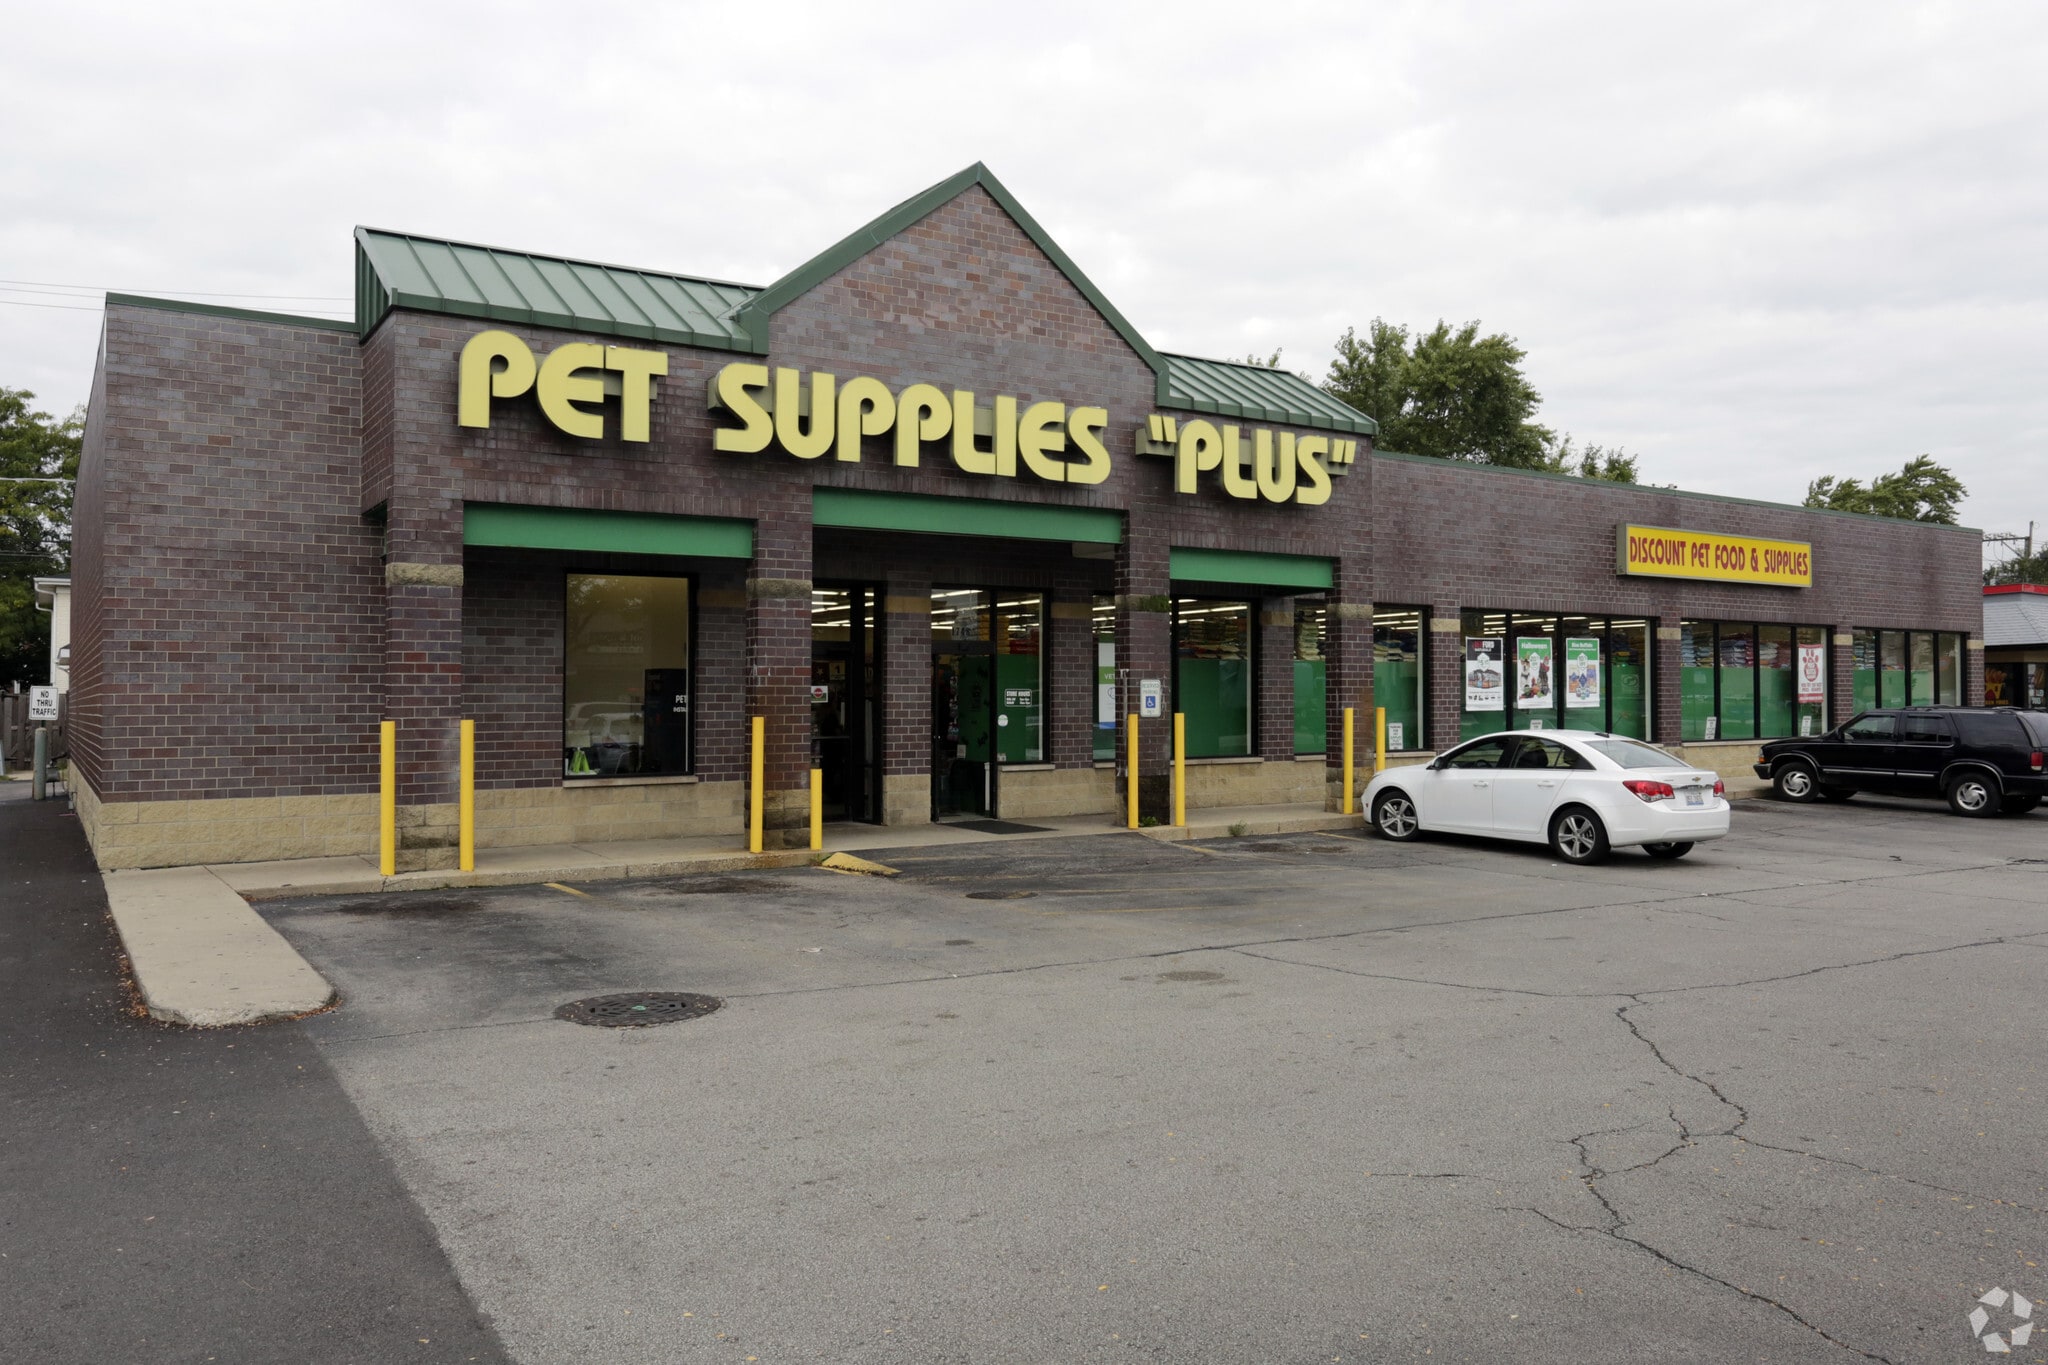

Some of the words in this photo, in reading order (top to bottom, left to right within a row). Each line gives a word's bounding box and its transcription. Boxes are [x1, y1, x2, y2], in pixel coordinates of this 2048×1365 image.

[459, 330, 668, 443] PET
[713, 362, 1112, 484] SUPPLIES
[1148, 414, 1357, 505] "PLUS"
[1629, 536, 1686, 566] DISCOUNT
[1691, 542, 1710, 568] PET
[1715, 544, 1745, 571] FOOD
[1750, 548, 1759, 572] &
[1764, 549, 1808, 576] SUPPLIES
[32, 707, 56, 716] TRAFFIC
[37, 699, 53, 707] THRU
